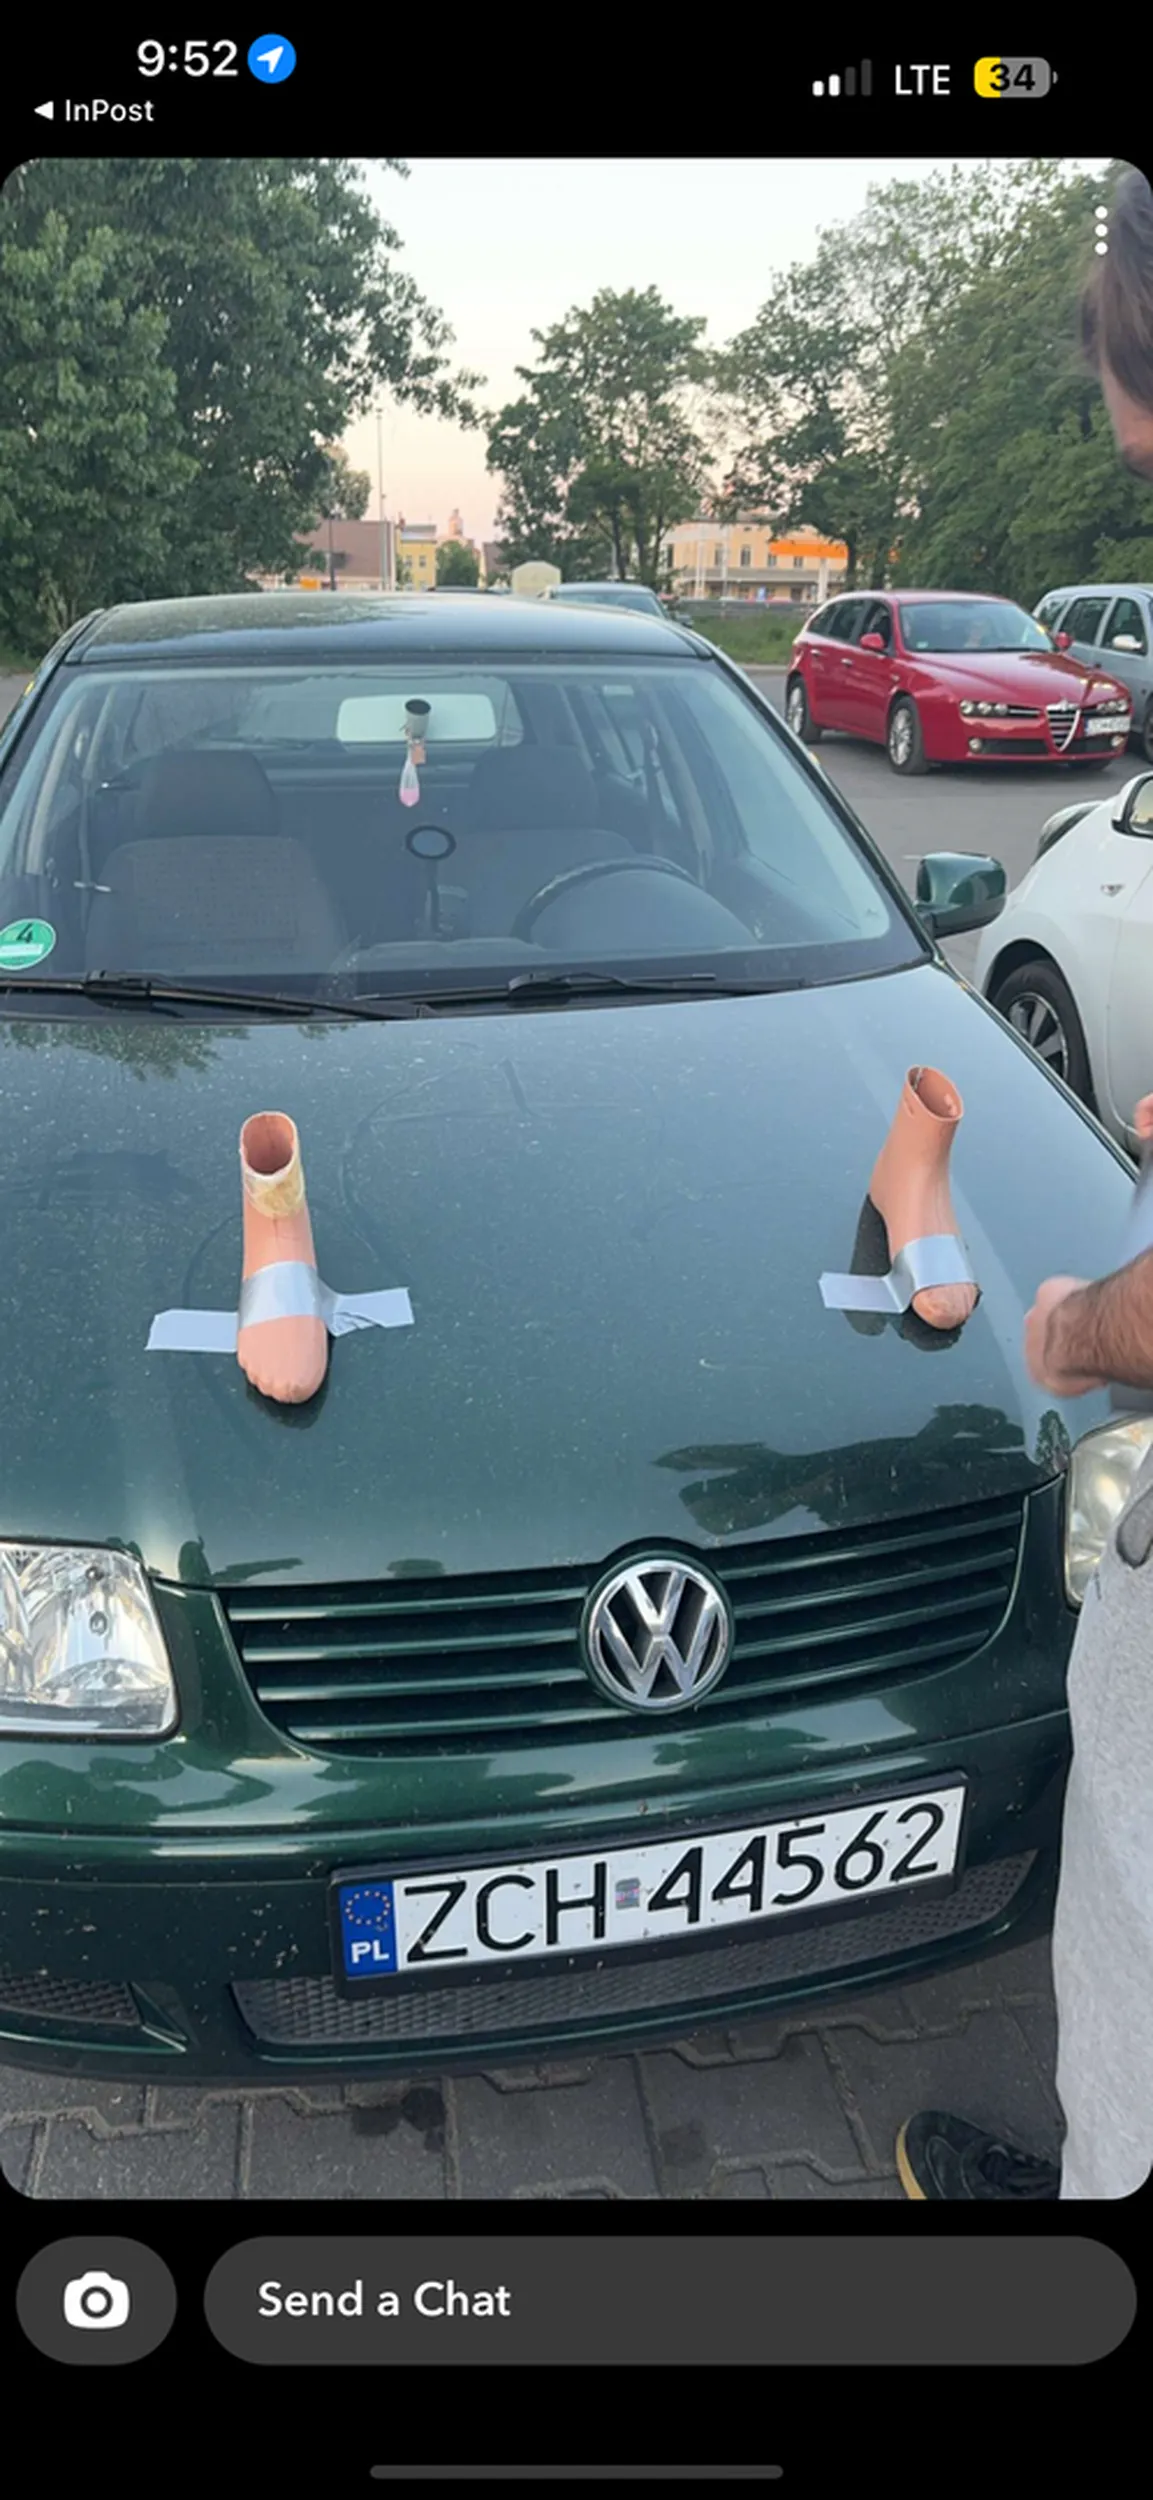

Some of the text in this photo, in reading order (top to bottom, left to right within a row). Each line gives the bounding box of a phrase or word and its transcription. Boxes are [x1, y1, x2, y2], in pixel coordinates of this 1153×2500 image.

[16, 922, 33, 944] 4
[591, 1562, 727, 1706] VW
[403, 1803, 945, 1964] ZCH 44562
[351, 1940, 390, 1964] PL
